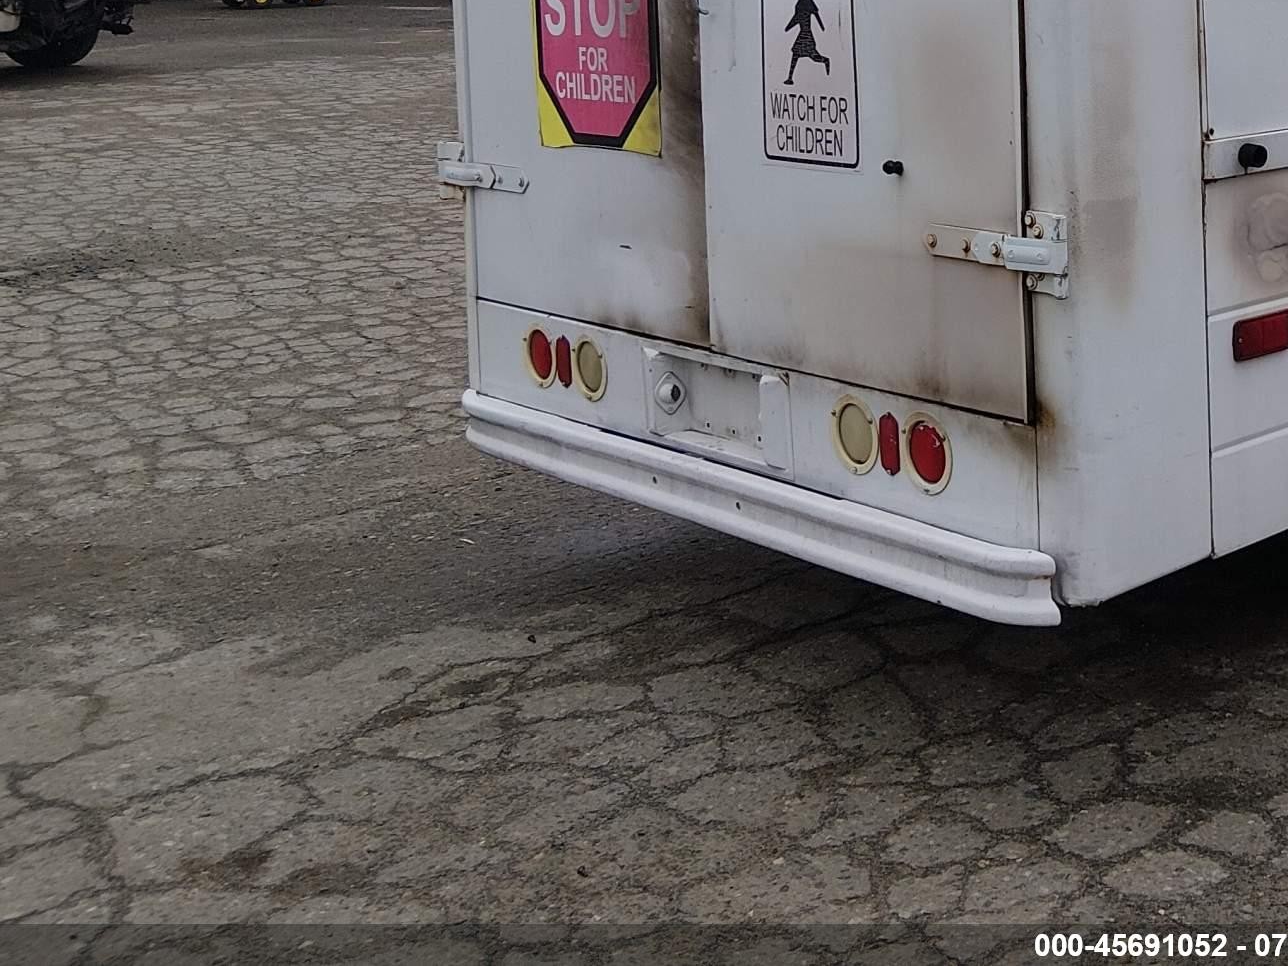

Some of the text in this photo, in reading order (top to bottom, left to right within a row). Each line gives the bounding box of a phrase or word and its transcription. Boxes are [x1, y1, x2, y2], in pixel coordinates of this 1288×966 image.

[578, 46, 608, 72] FOR
[555, 72, 636, 105] CHILDREN
[770, 92, 849, 125] WATCH FOR
[776, 124, 844, 157] CHILDREN
